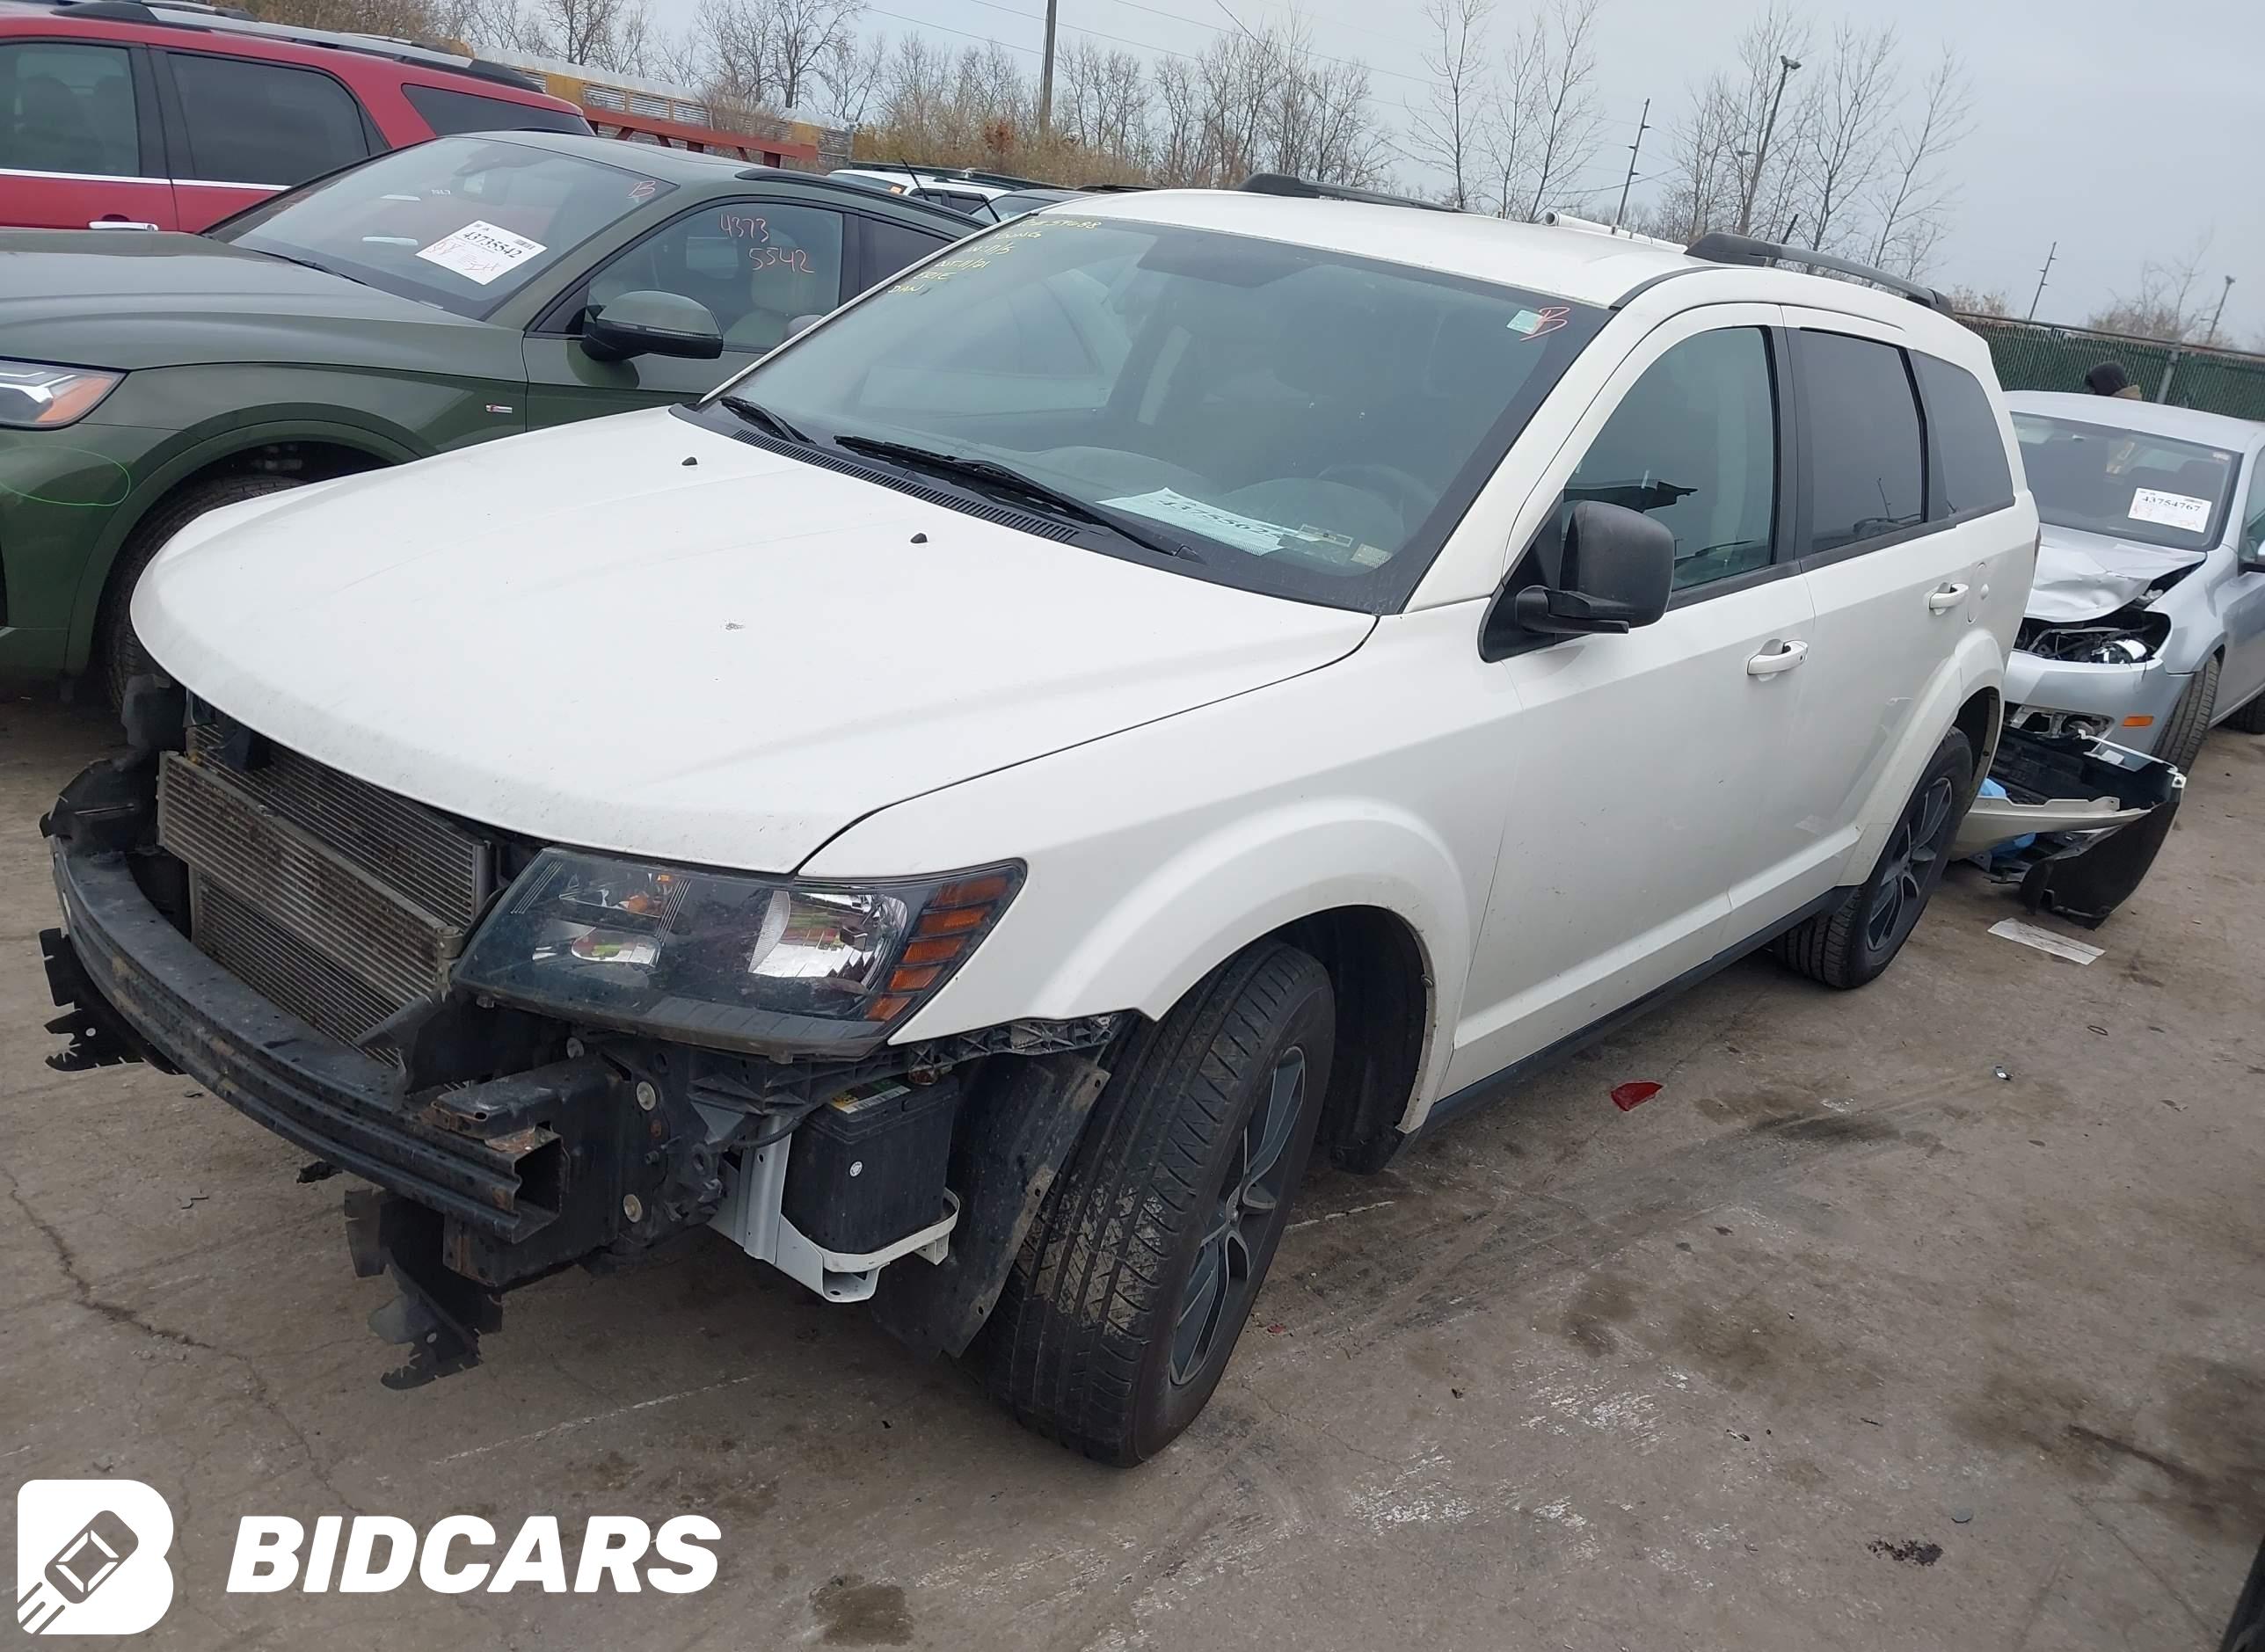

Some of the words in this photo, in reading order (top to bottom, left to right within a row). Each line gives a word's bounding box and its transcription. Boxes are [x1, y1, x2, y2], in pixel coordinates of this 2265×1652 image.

[720, 214, 769, 243] 4373
[463, 231, 522, 258] 43735542
[747, 247, 815, 274] 5542
